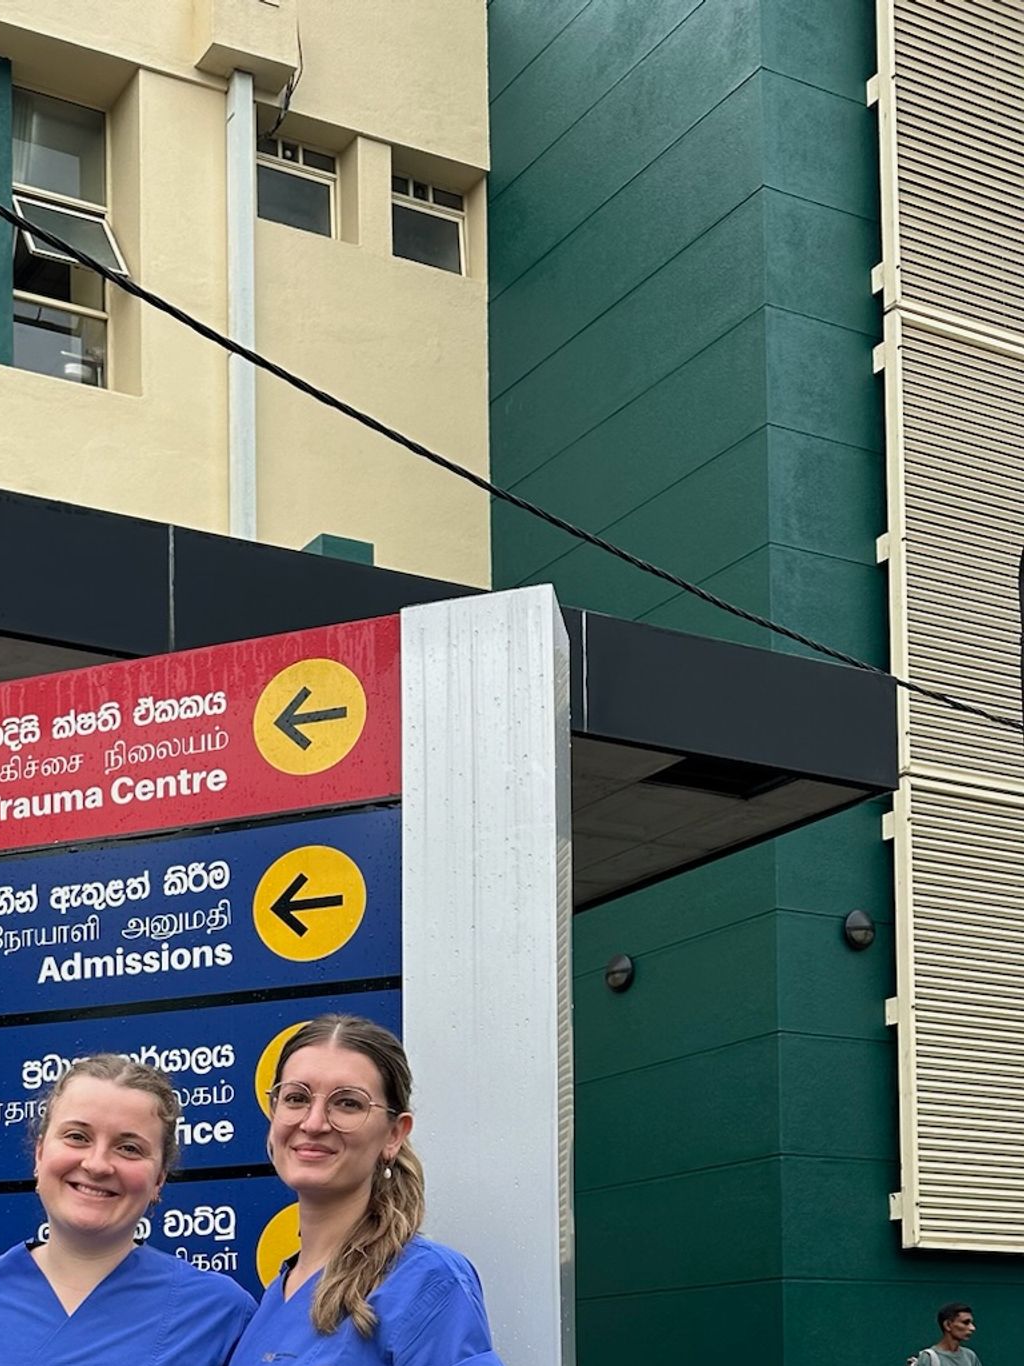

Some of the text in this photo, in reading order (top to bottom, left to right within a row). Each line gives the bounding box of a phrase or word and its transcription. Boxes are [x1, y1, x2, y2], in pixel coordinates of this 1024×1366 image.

[133, 691, 227, 726] ඒකකය
[104, 726, 229, 774] நிலையம்
[110, 768, 227, 804] Centre
[163, 860, 231, 896] කිරීම
[121, 899, 232, 940] அனுமதி
[37, 942, 233, 984] Admissions
[175, 1116, 234, 1145] fice
[163, 1206, 236, 1241] වාට්ටු
